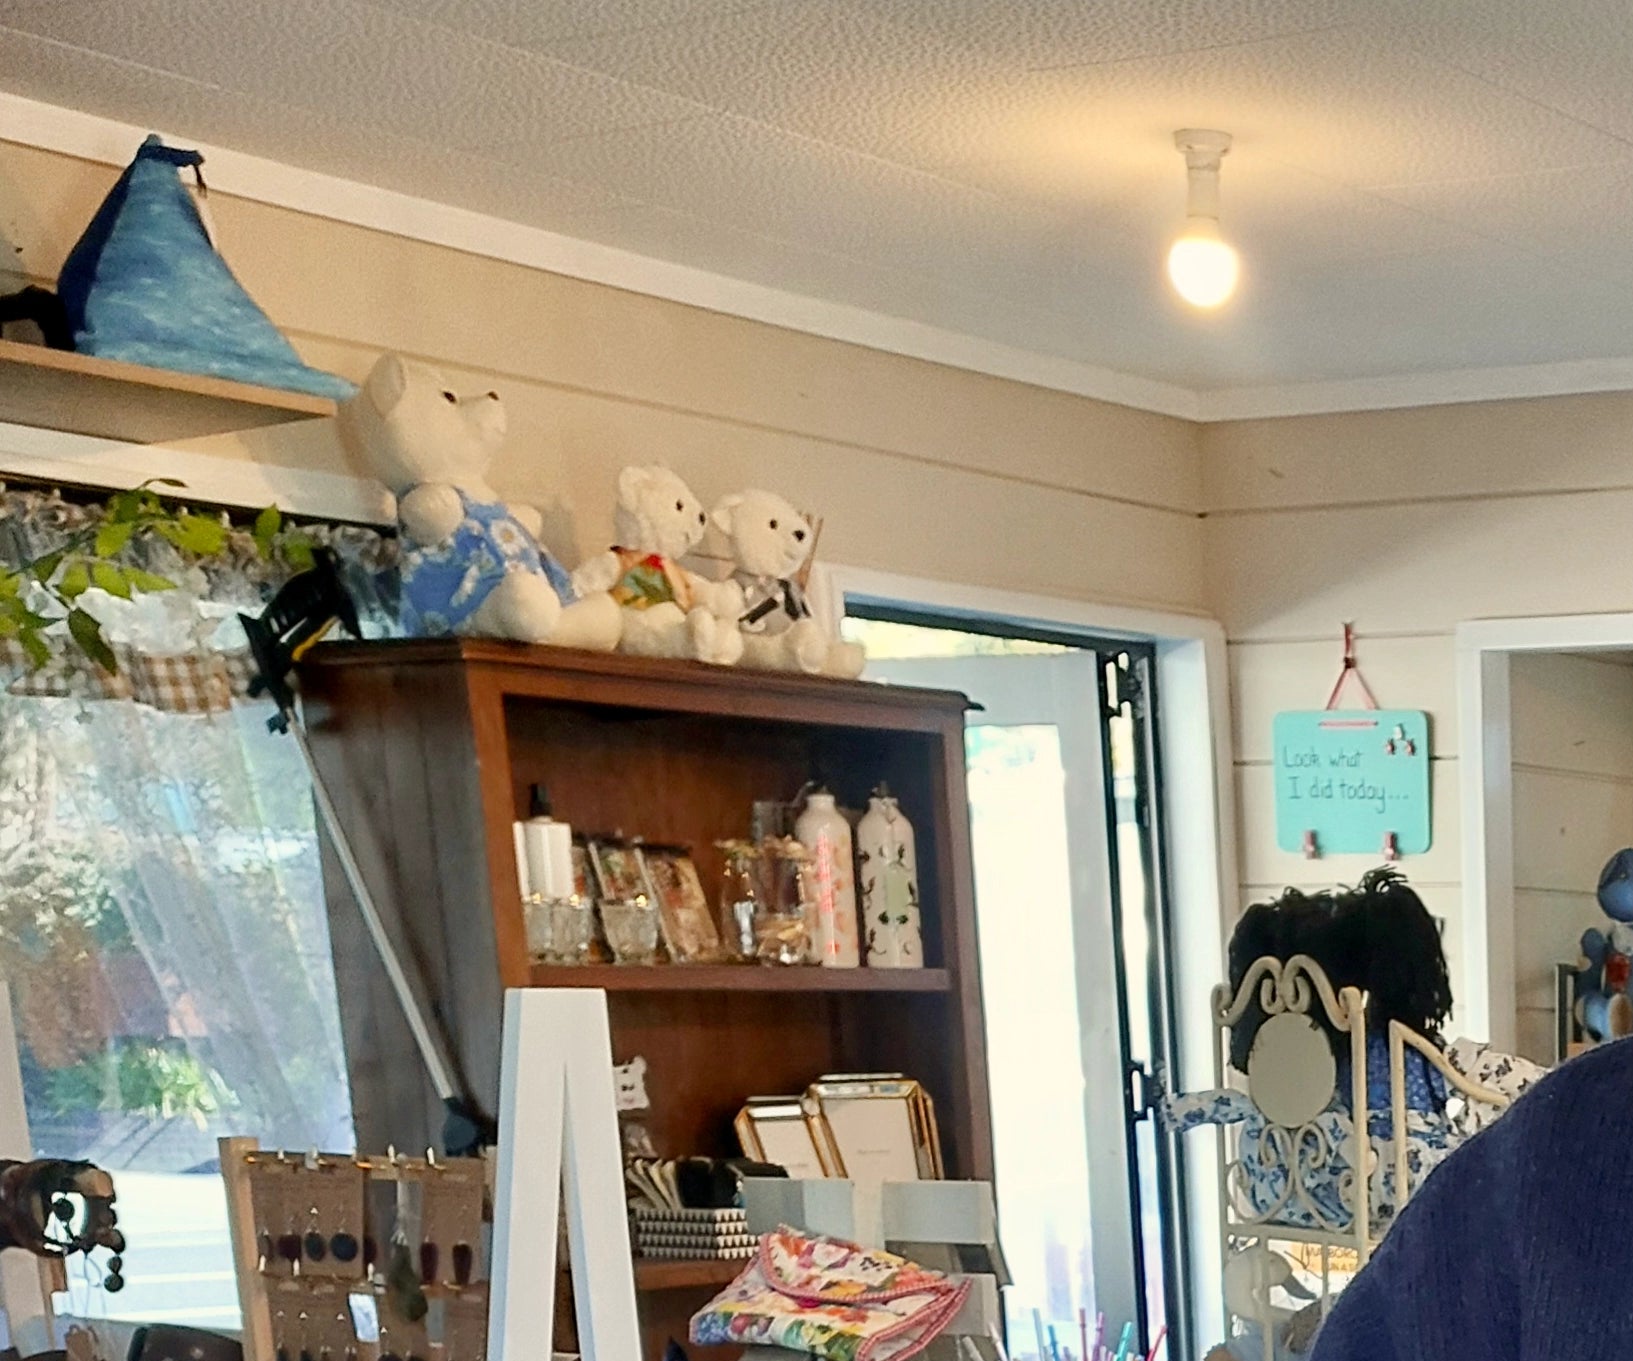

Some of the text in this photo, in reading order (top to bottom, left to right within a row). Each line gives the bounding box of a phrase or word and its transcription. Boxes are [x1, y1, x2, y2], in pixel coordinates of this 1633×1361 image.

[1282, 745, 1363, 768] Look what
[1288, 776, 1302, 799] I
[1309, 775, 1333, 799] did
